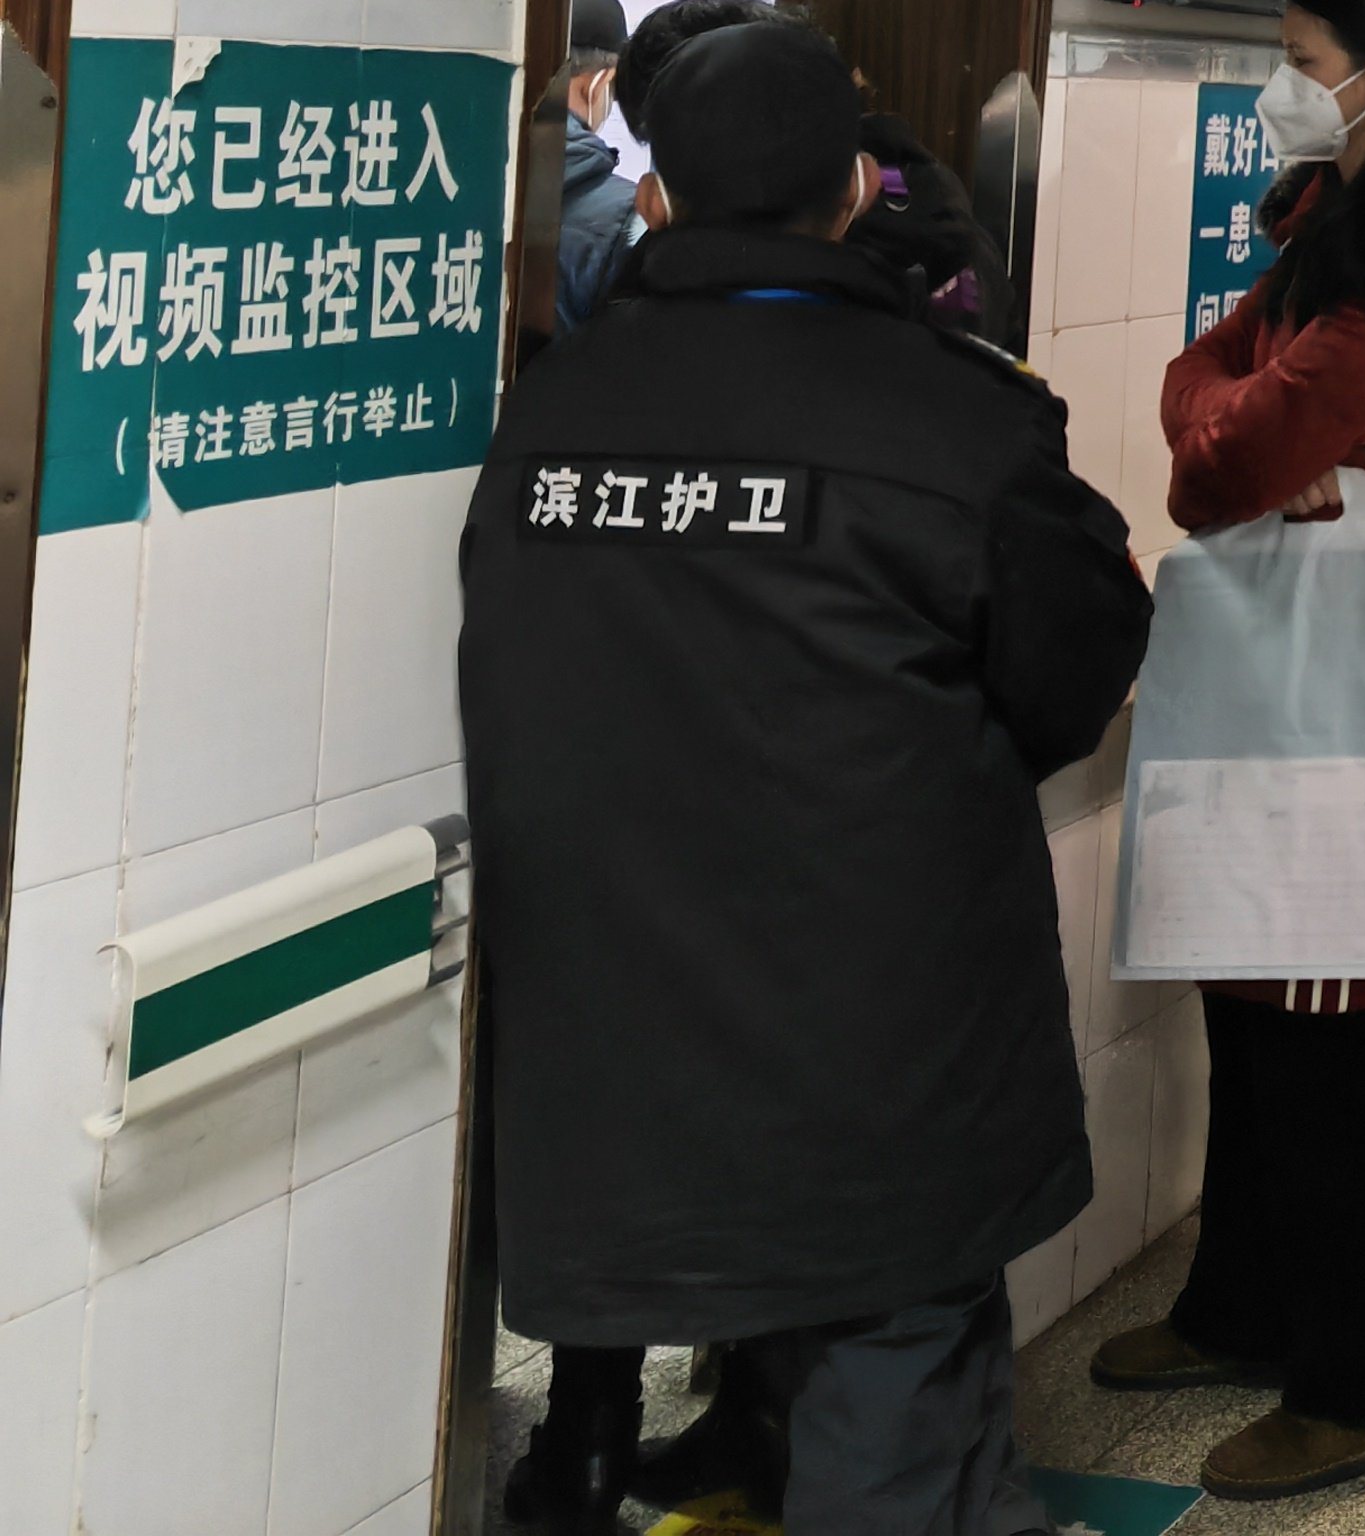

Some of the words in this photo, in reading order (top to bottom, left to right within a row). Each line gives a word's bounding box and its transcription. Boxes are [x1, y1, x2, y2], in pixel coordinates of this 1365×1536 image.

[124, 96, 459, 214] 您已经进入
[72, 229, 484, 372] 视频监控区域
[527, 466, 788, 534] 滨江护卫
